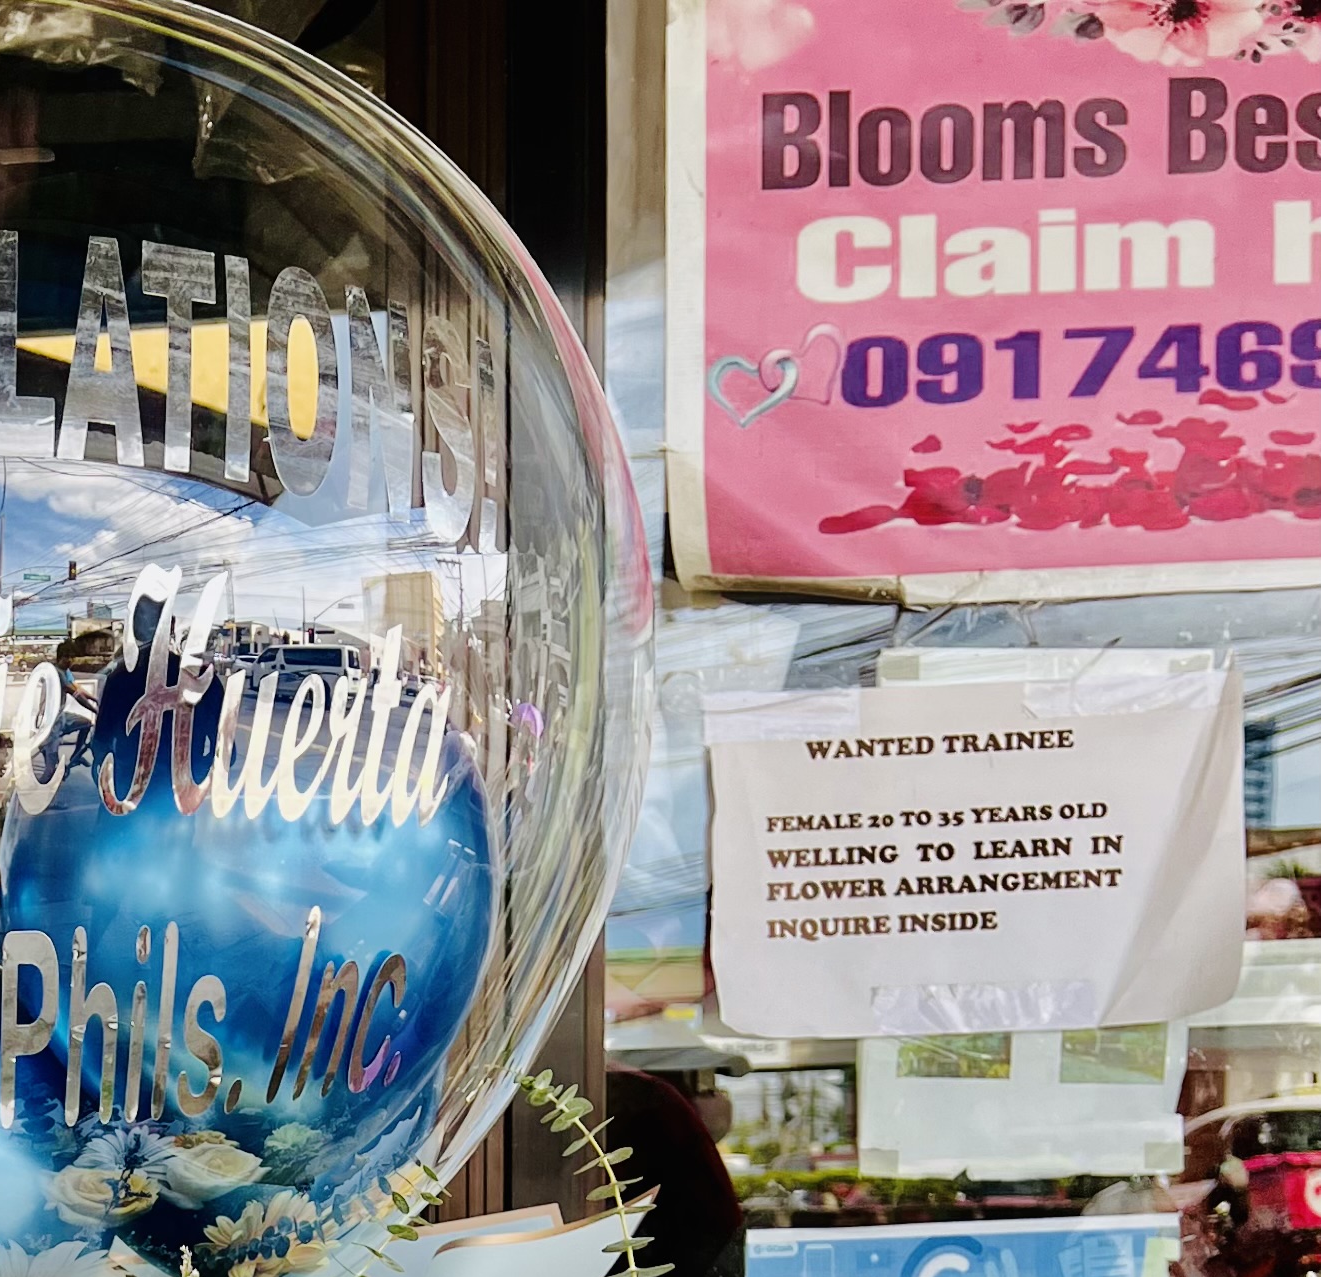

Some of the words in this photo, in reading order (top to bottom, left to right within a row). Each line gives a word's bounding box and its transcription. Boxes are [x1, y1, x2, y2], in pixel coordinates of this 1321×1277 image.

[760, 89, 1129, 190] Blooms
[795, 207, 1216, 301] Claim
[97, 562, 452, 830] Huerta
[805, 736, 935, 760] WANTED
[942, 729, 1074, 754] TRAINEE
[765, 813, 863, 833] FEMALE
[868, 814, 895, 829] 20
[899, 810, 932, 827] TO
[937, 811, 965, 827] 35
[971, 804, 1053, 824] YEARS
[1059, 802, 1108, 820] OLD
[766, 844, 899, 869] WELLING
[916, 843, 955, 862] TO
[973, 837, 1073, 861] LEARN
[1090, 834, 1123, 855] IN
[766, 875, 887, 901] FLOWER
[894, 868, 1122, 897] ARRANGEMENT
[766, 914, 891, 942] INQUIRE
[898, 910, 998, 932] INSIDE
[266, 905, 408, 1104] Inc.
